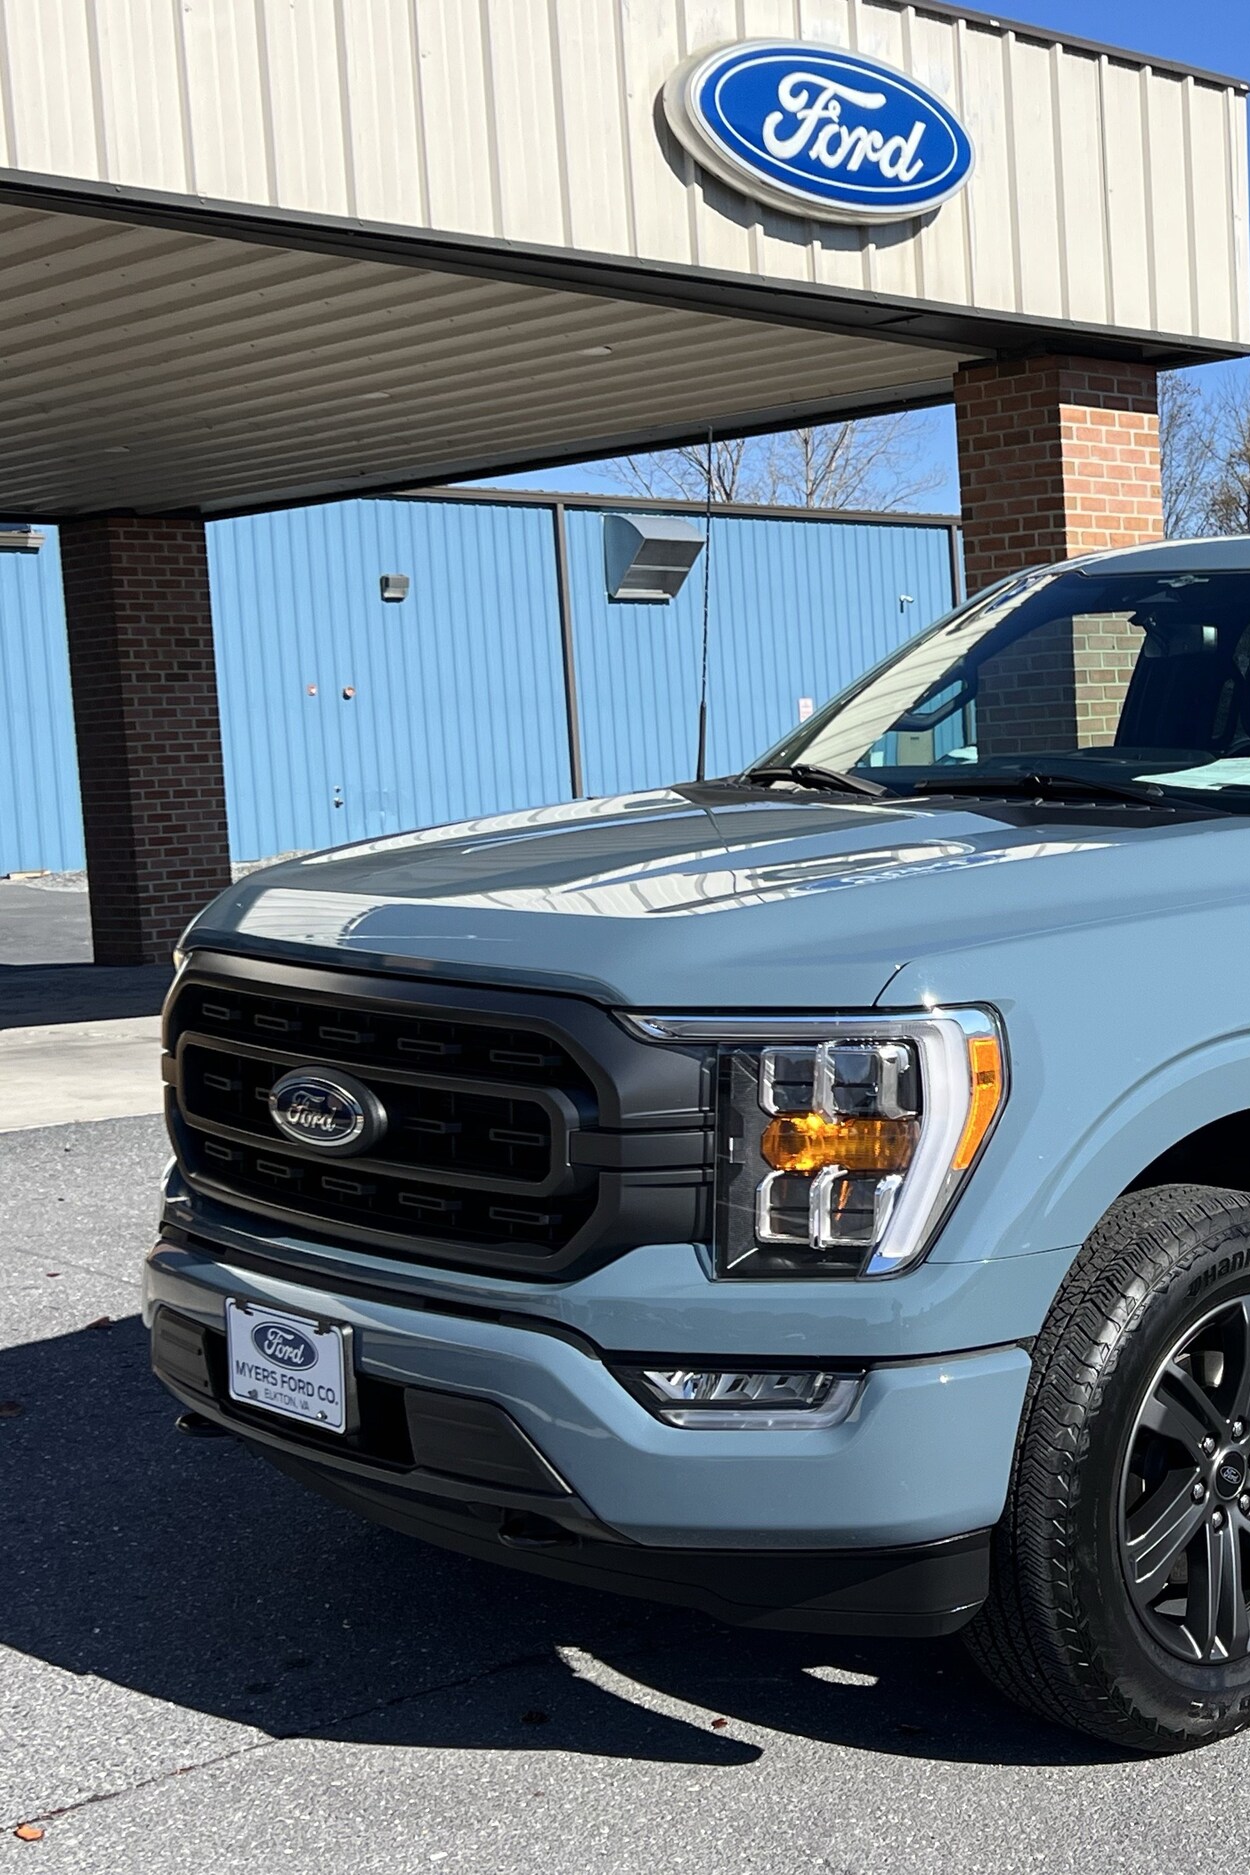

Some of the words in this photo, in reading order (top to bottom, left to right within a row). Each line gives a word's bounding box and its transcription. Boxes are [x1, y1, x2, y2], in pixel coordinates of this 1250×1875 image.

[762, 71, 927, 183] Ford
[286, 1090, 336, 1132] Ford
[263, 1327, 306, 1365] Ford
[235, 1359, 278, 1387] MYERS
[280, 1373, 315, 1398] FORD
[317, 1385, 340, 1406] CO.
[299, 1400, 310, 1411] VA
